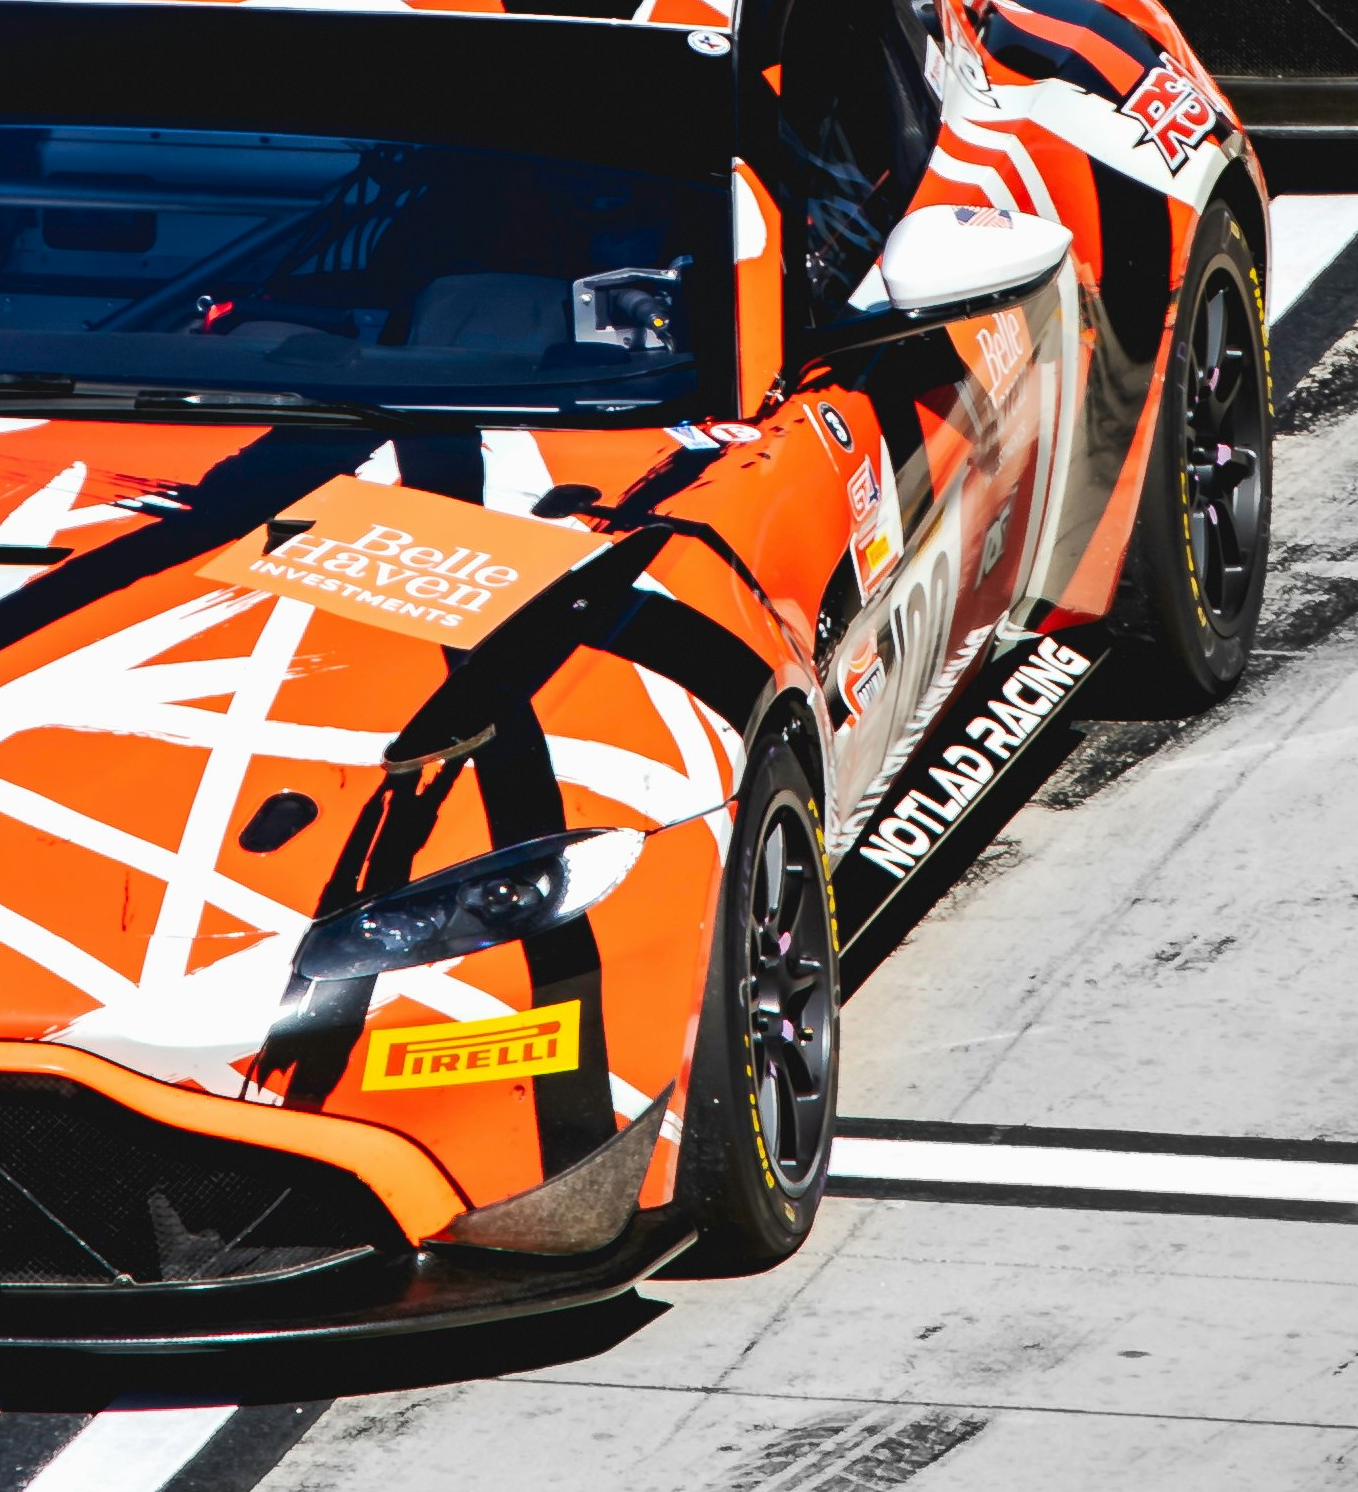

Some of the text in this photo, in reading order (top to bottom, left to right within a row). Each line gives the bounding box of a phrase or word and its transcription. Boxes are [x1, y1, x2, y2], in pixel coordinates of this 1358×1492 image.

[268, 531, 493, 613] Haven
[341, 522, 519, 588] Belle
[249, 558, 464, 628] INVESTMENTS
[859, 744, 995, 879] NOTLAD
[964, 636, 1092, 760] RACING
[385, 1020, 561, 1077] PIRELLI
